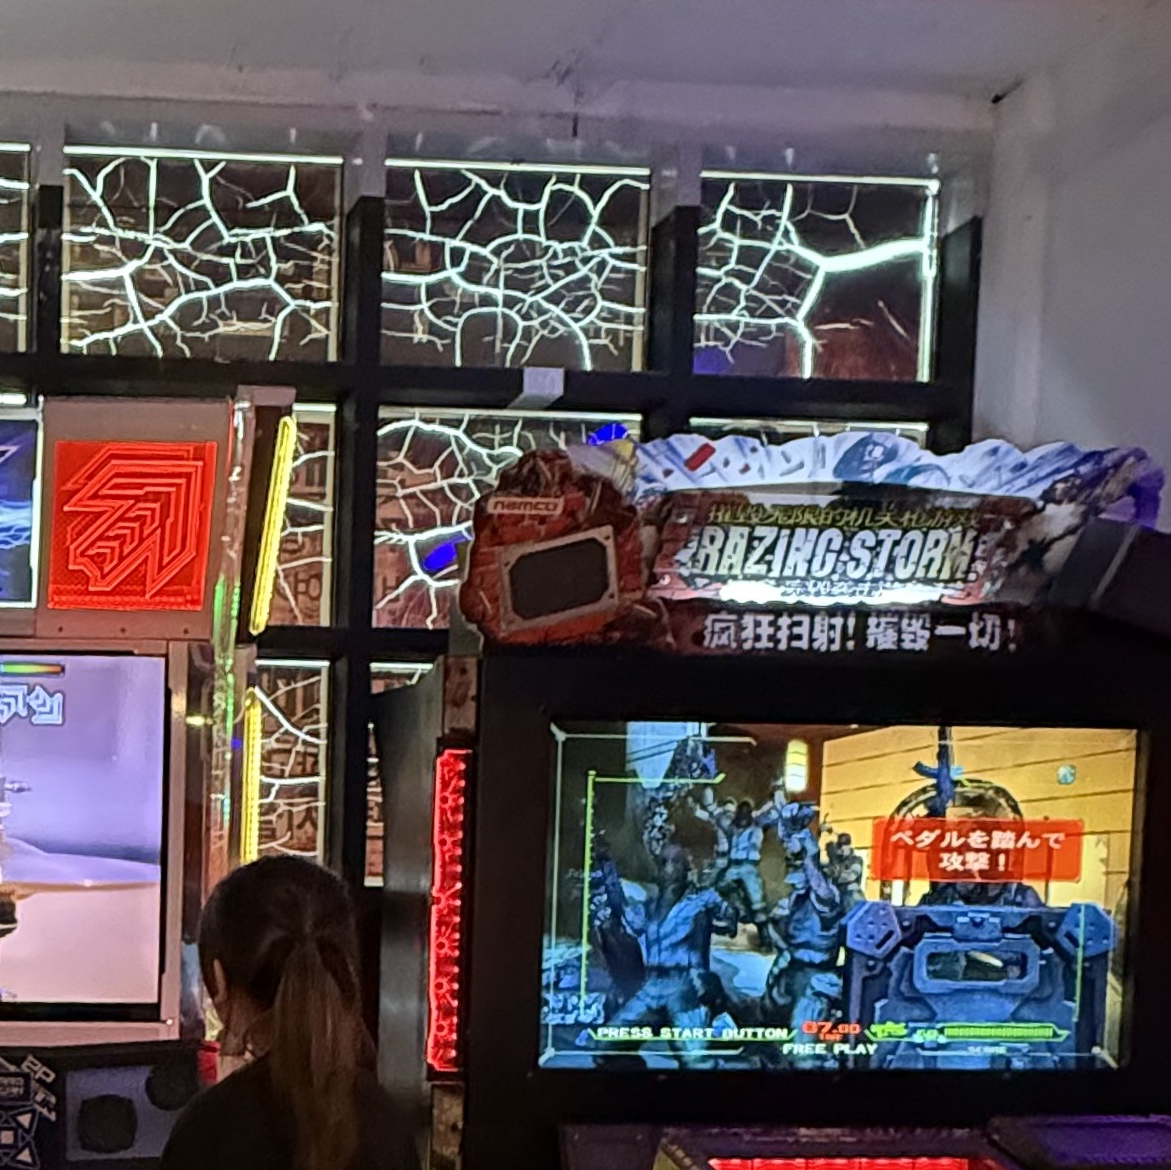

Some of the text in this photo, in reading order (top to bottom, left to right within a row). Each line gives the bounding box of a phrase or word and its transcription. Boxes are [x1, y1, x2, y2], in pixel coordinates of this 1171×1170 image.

[492, 500, 559, 512] namco
[697, 526, 978, 581] RAZING STORM
[596, 1027, 788, 1039] PRESS START BUTTON
[782, 1043, 878, 1055] FREE PLAY
[21, 1055, 56, 1083] 2P
